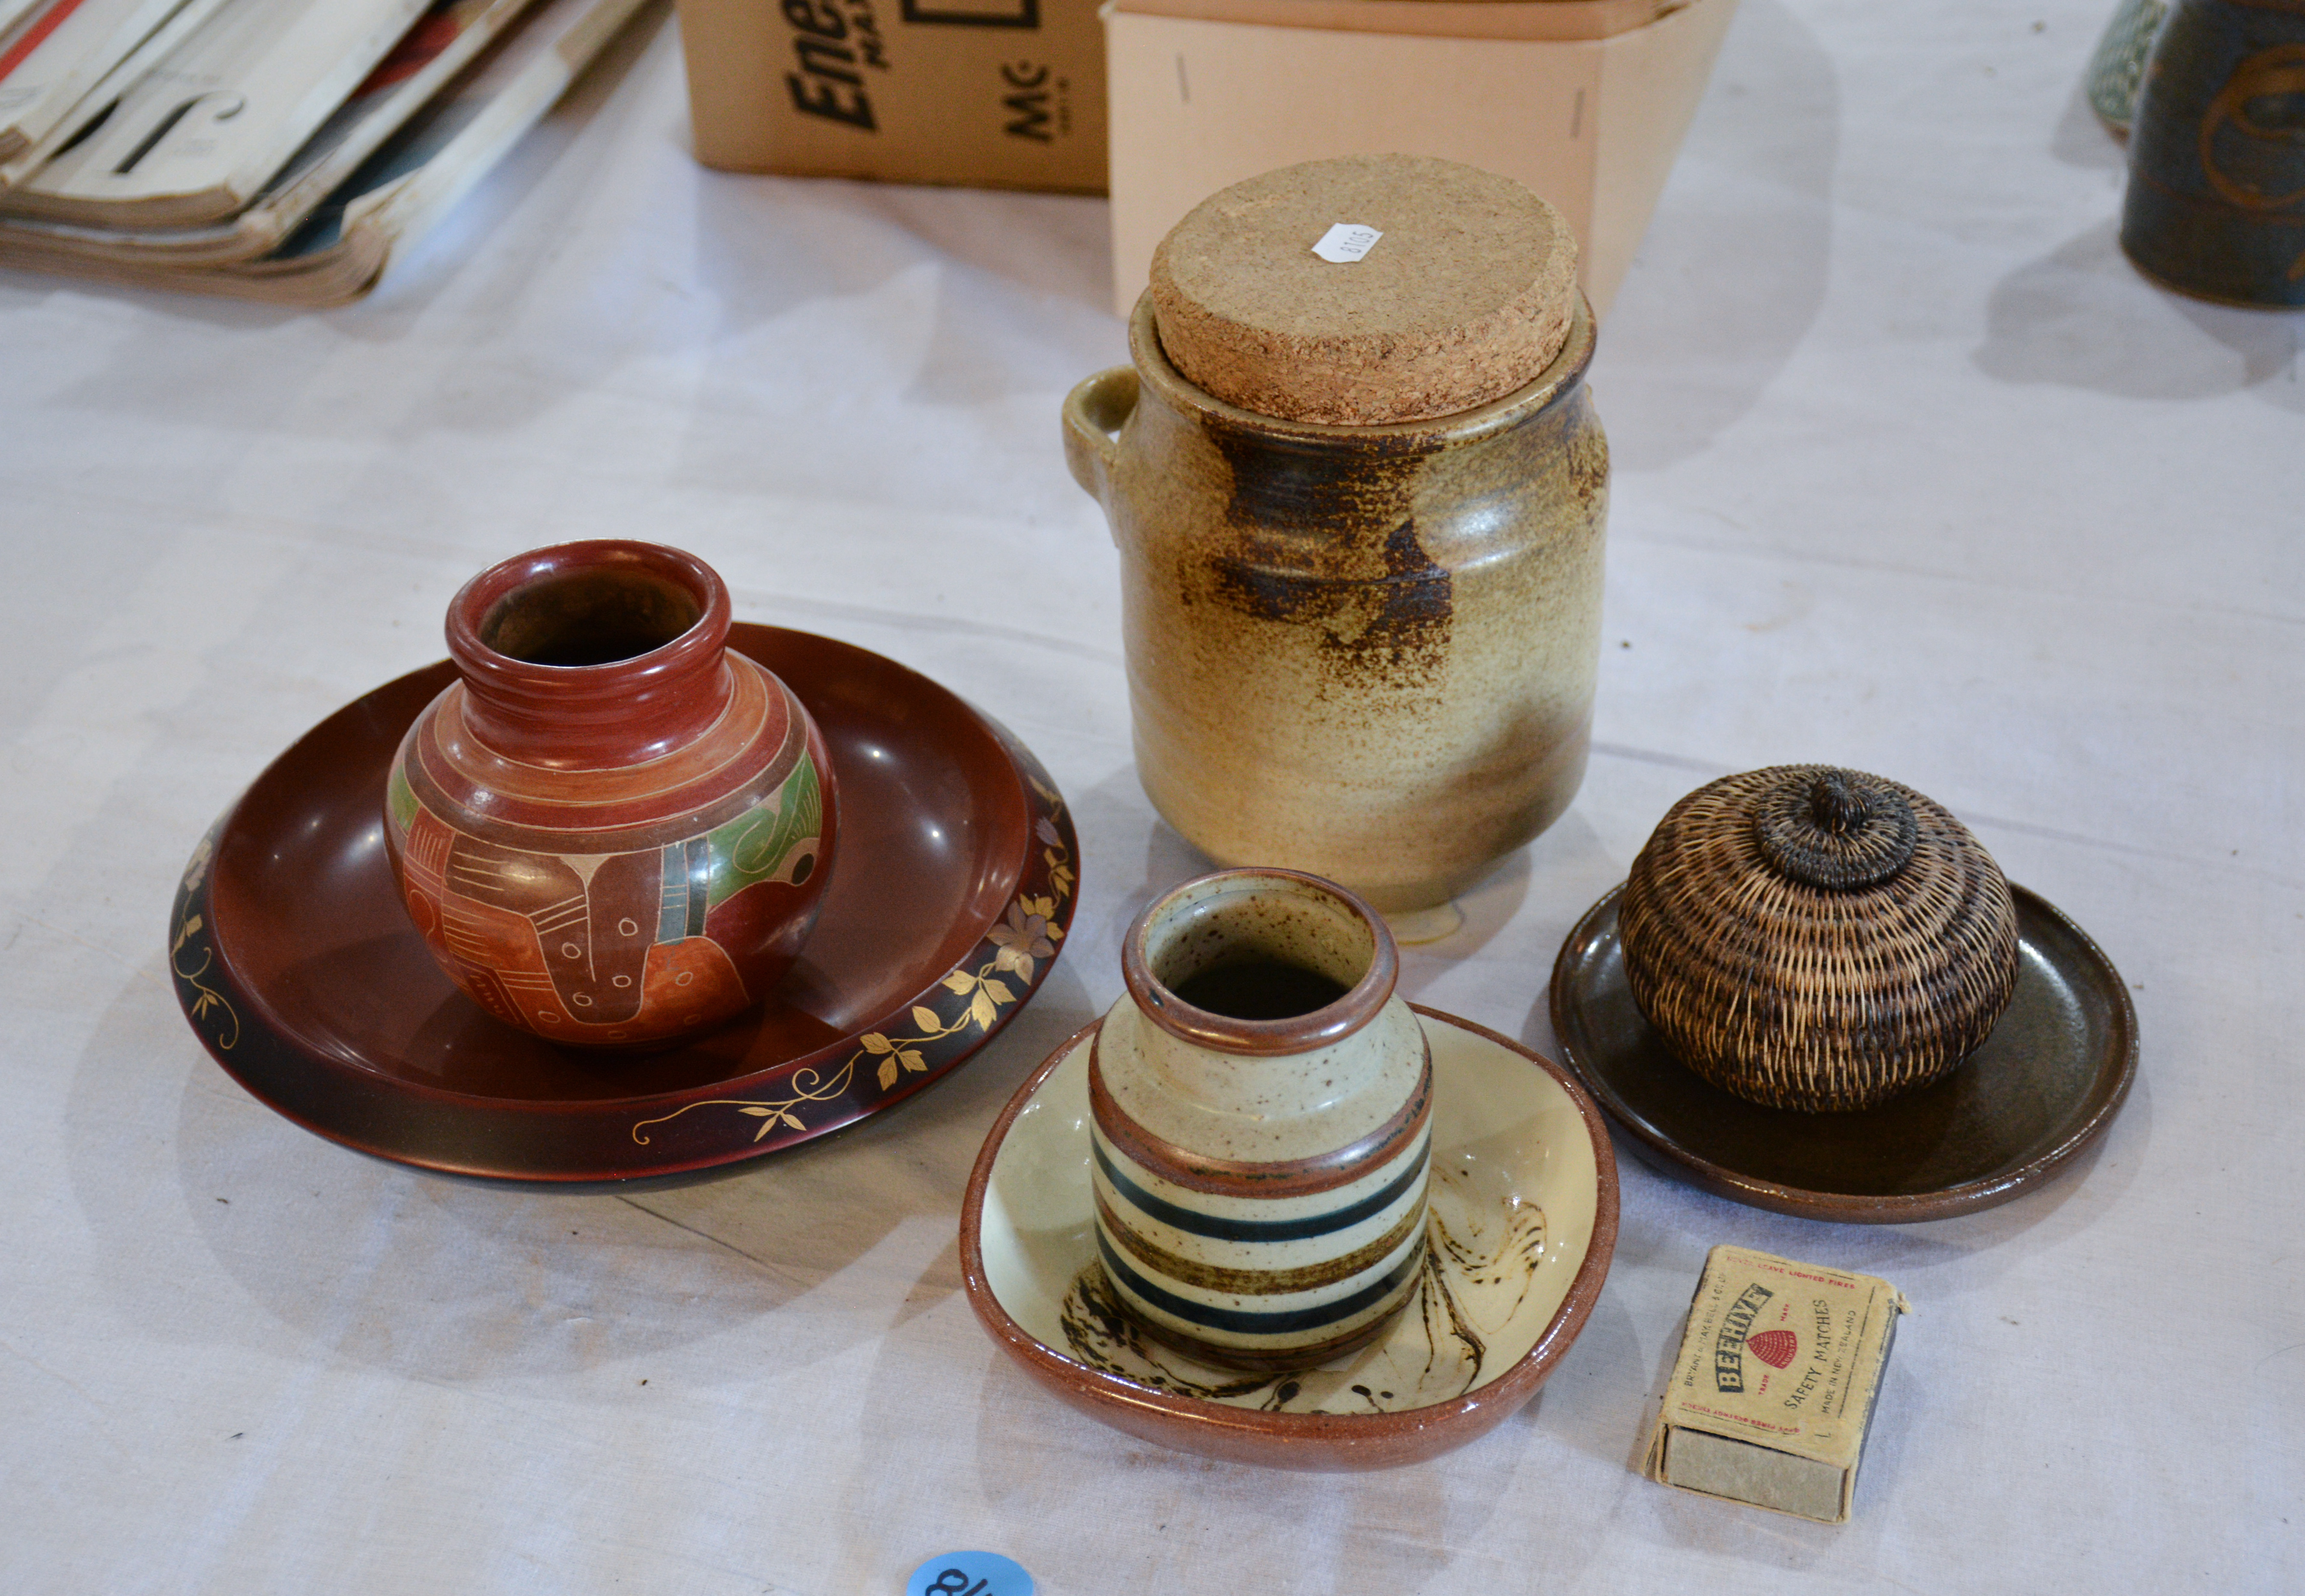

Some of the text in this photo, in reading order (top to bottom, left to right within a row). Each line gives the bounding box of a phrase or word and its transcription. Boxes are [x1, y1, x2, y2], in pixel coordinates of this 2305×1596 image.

[844, 0, 892, 70] MA
[1339, 231, 1373, 253] 8105
[1789, 1270, 1825, 1282] LIGHTED
[1828, 1279, 1855, 1289] FIRES
[1684, 1354, 1702, 1387] BRYANT
[1717, 1286, 1768, 1387] BEEHIVE
[1758, 1304, 1790, 1396] TRADE MARK
[1779, 1334, 1795, 1367] INDUSTRY
[1784, 1366, 1822, 1410] SAFETY
[1813, 1300, 1831, 1362] MATCHES
[1821, 1389, 1836, 1414] MADE
[1829, 1377, 1838, 1387] IN
[1838, 1310, 1856, 1353] ZEALAND
